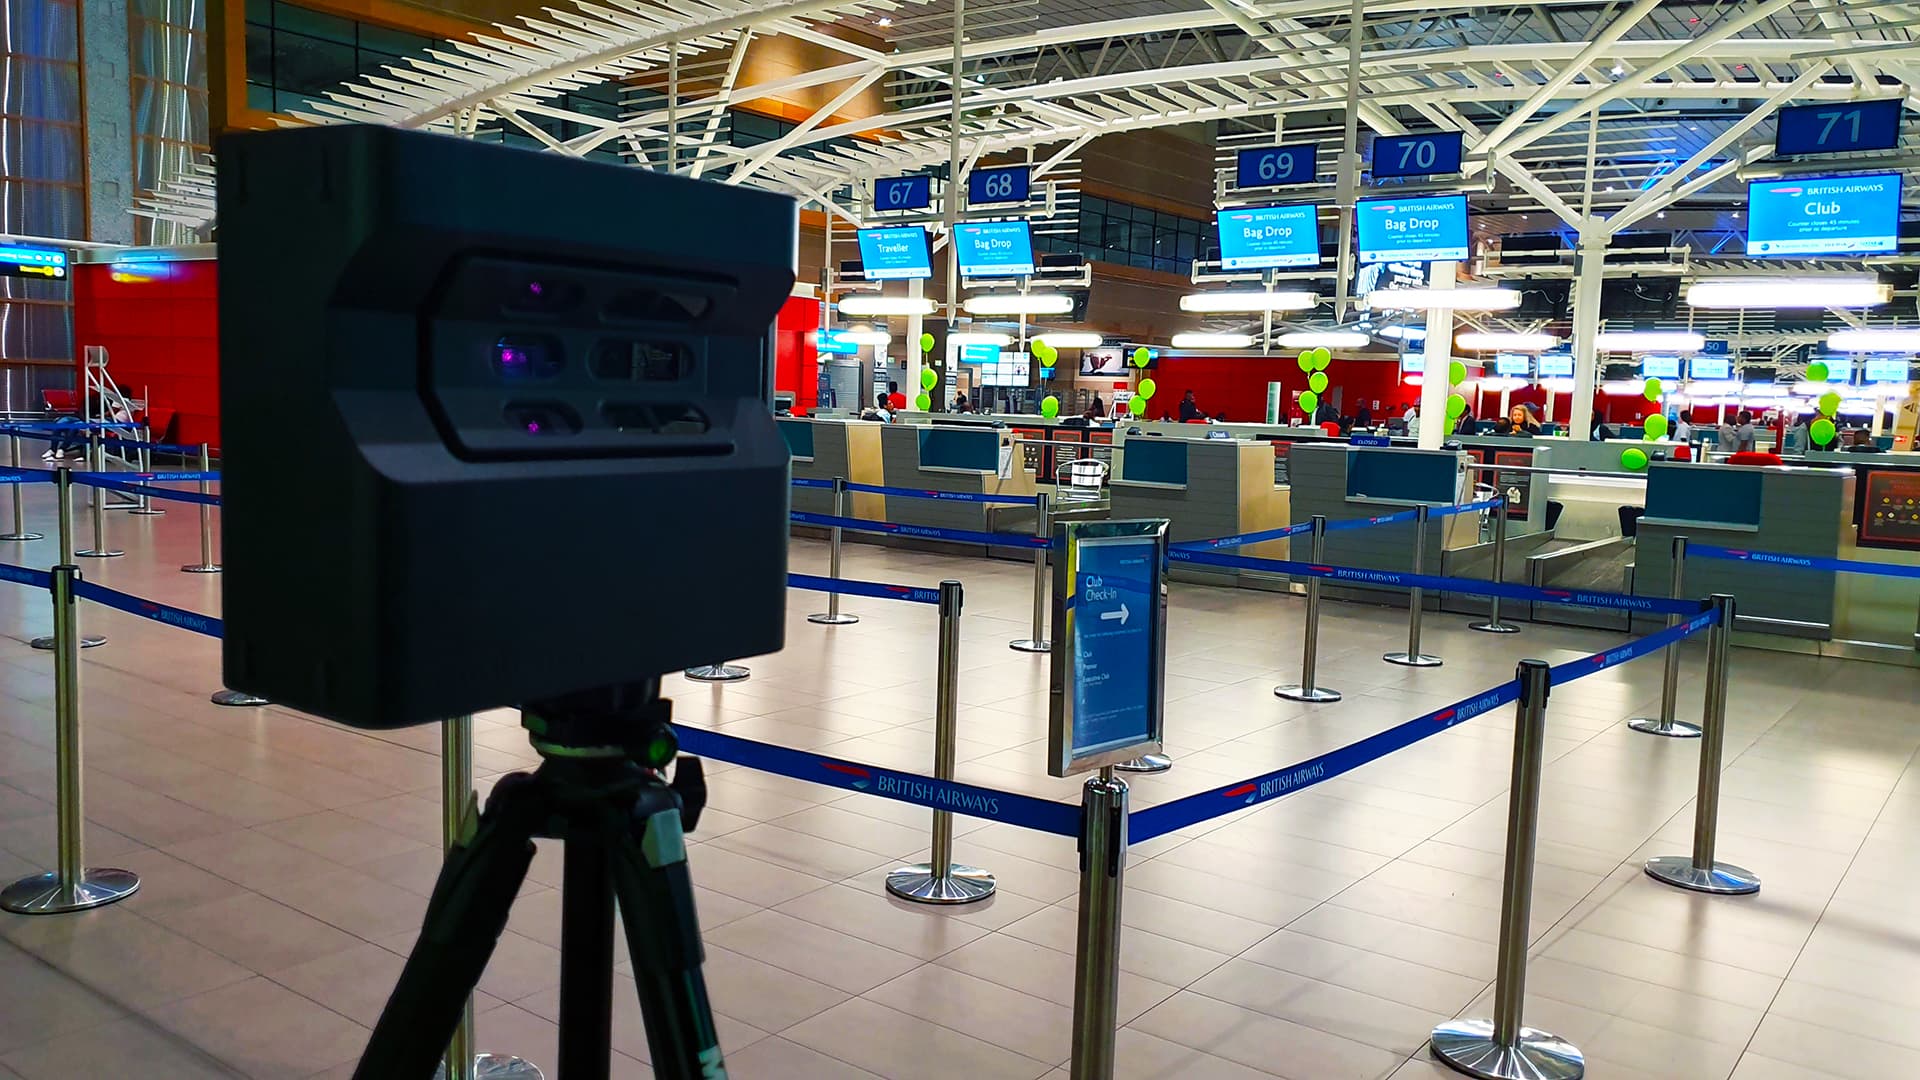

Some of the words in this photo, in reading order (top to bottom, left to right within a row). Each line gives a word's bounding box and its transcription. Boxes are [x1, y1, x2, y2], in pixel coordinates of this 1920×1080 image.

[1816, 110, 1862, 145] 71
[1397, 140, 1436, 169] 70
[1258, 152, 1294, 180] 69
[985, 173, 1013, 197] 68
[1807, 186, 1843, 195] BRITISH
[1844, 183, 1884, 193] AIRWAYS
[888, 182, 914, 204] 67
[1398, 205, 1425, 213] BRITISH
[1426, 203, 1455, 211] AIRWAYS
[1804, 200, 1841, 215] Club
[1280, 212, 1306, 220] AIRWAYS
[1384, 219, 1407, 232] Bag
[1409, 217, 1440, 231] Drop
[1243, 227, 1263, 240] Bag
[1265, 226, 1293, 238] Drop
[876, 243, 909, 253] Traveller
[974, 239, 990, 250] Bag
[991, 238, 1012, 249] Drop
[1706, 342, 1720, 351] 50
[900, 525, 920, 534] BRITISH
[920, 528, 941, 537] AIRWAYS
[1751, 553, 1781, 563] BRITISH
[1781, 556, 1811, 566] AIRWAYS
[1086, 575, 1103, 588] Club
[1337, 569, 1368, 580] BRITISH
[1368, 572, 1401, 583] AIRWAYS
[1085, 586, 1117, 602] Check-In
[1577, 593, 1612, 606] BRITISH
[1613, 597, 1652, 609] AIRWAYS
[1456, 700, 1479, 721] BRITISH
[1478, 692, 1500, 711] AIRWAYS
[1260, 774, 1292, 798] BRITISH
[1292, 761, 1325, 787] AIRWAYS
[877, 775, 934, 802] BRITISH
[936, 787, 999, 816] AIRWAYS
